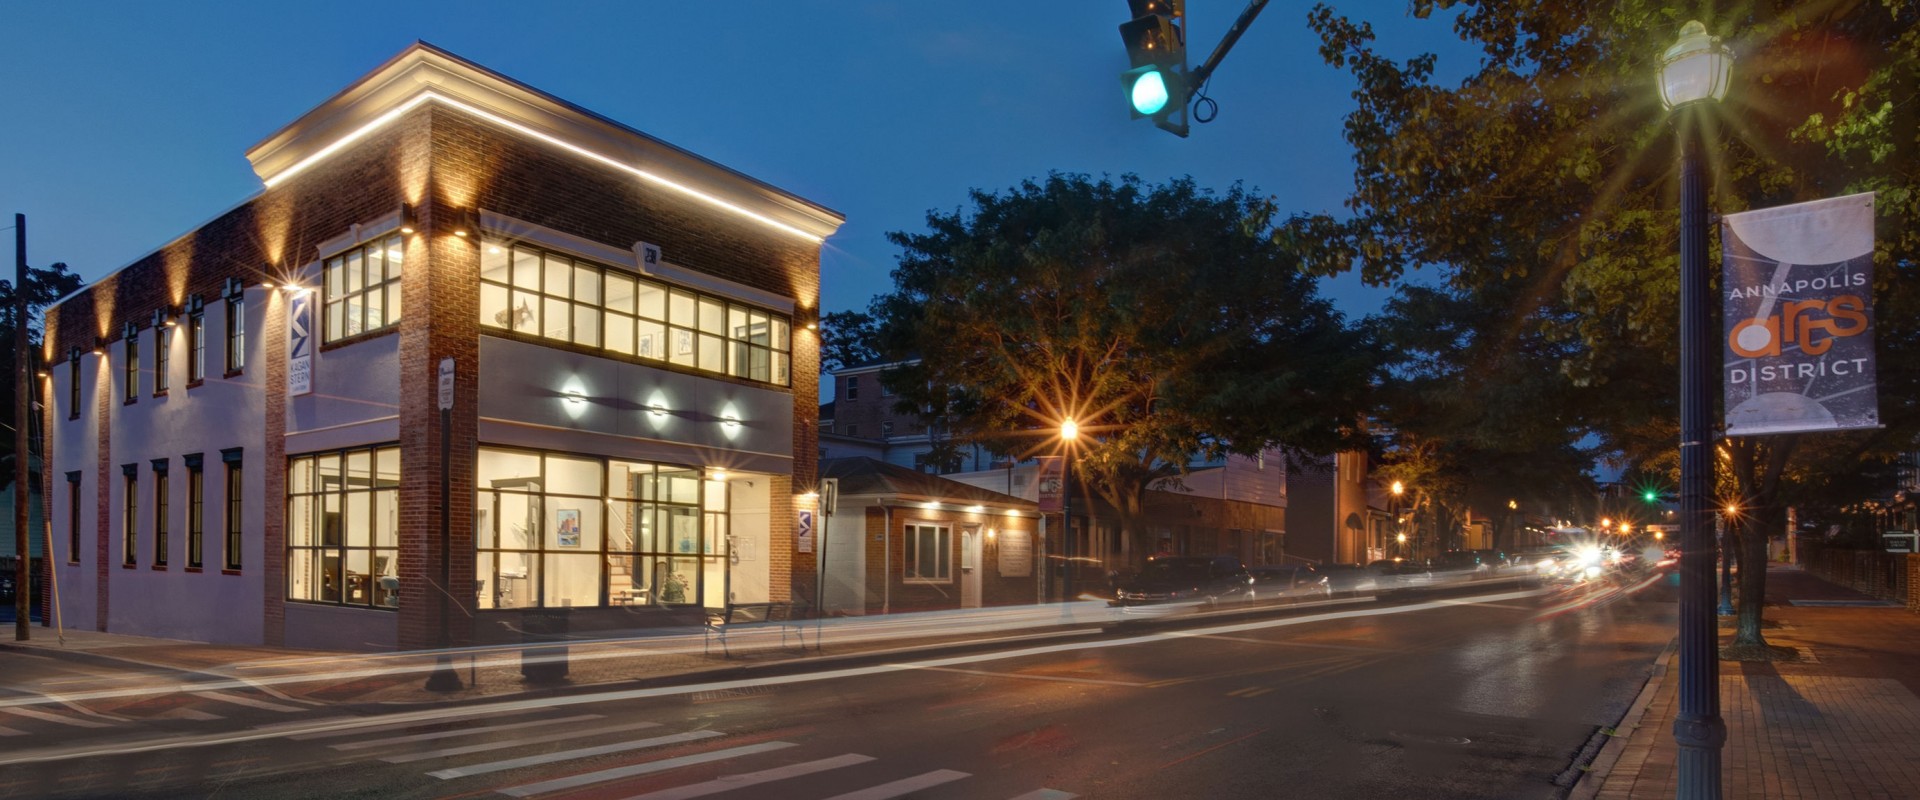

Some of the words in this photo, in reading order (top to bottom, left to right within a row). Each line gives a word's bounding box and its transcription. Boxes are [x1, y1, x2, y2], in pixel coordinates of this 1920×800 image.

[1729, 273, 1866, 300] ANNAPOLIS
[1729, 296, 1868, 357] arts
[290, 360, 310, 372] KAGAN
[290, 372, 310, 385] STERN
[1731, 358, 1867, 384] DISTRICT
